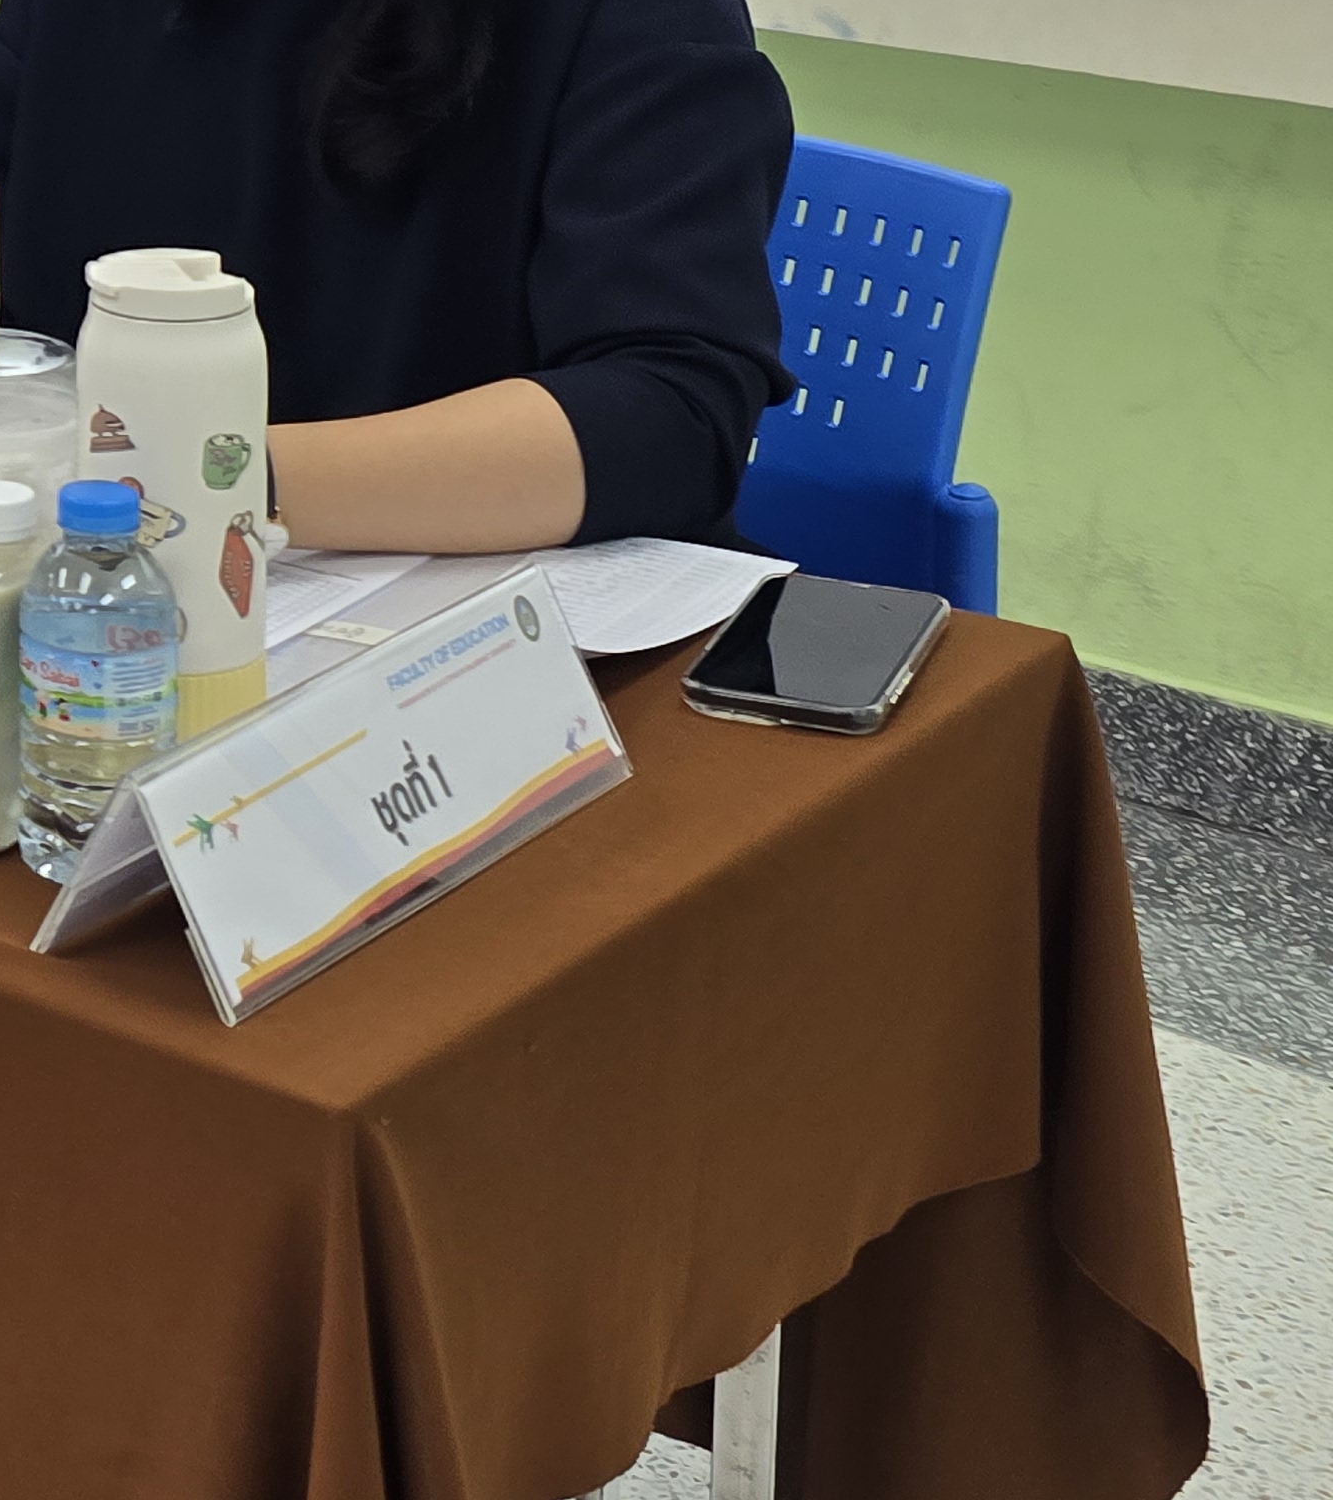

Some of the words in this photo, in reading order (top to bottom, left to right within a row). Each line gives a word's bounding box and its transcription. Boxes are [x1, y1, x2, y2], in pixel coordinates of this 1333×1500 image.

[386, 650, 437, 691] FACULTY
[434, 644, 452, 665] OF
[448, 613, 511, 657] EDUCATION
[370, 738, 438, 847] ชุดที่
[427, 753, 453, 799] 1
